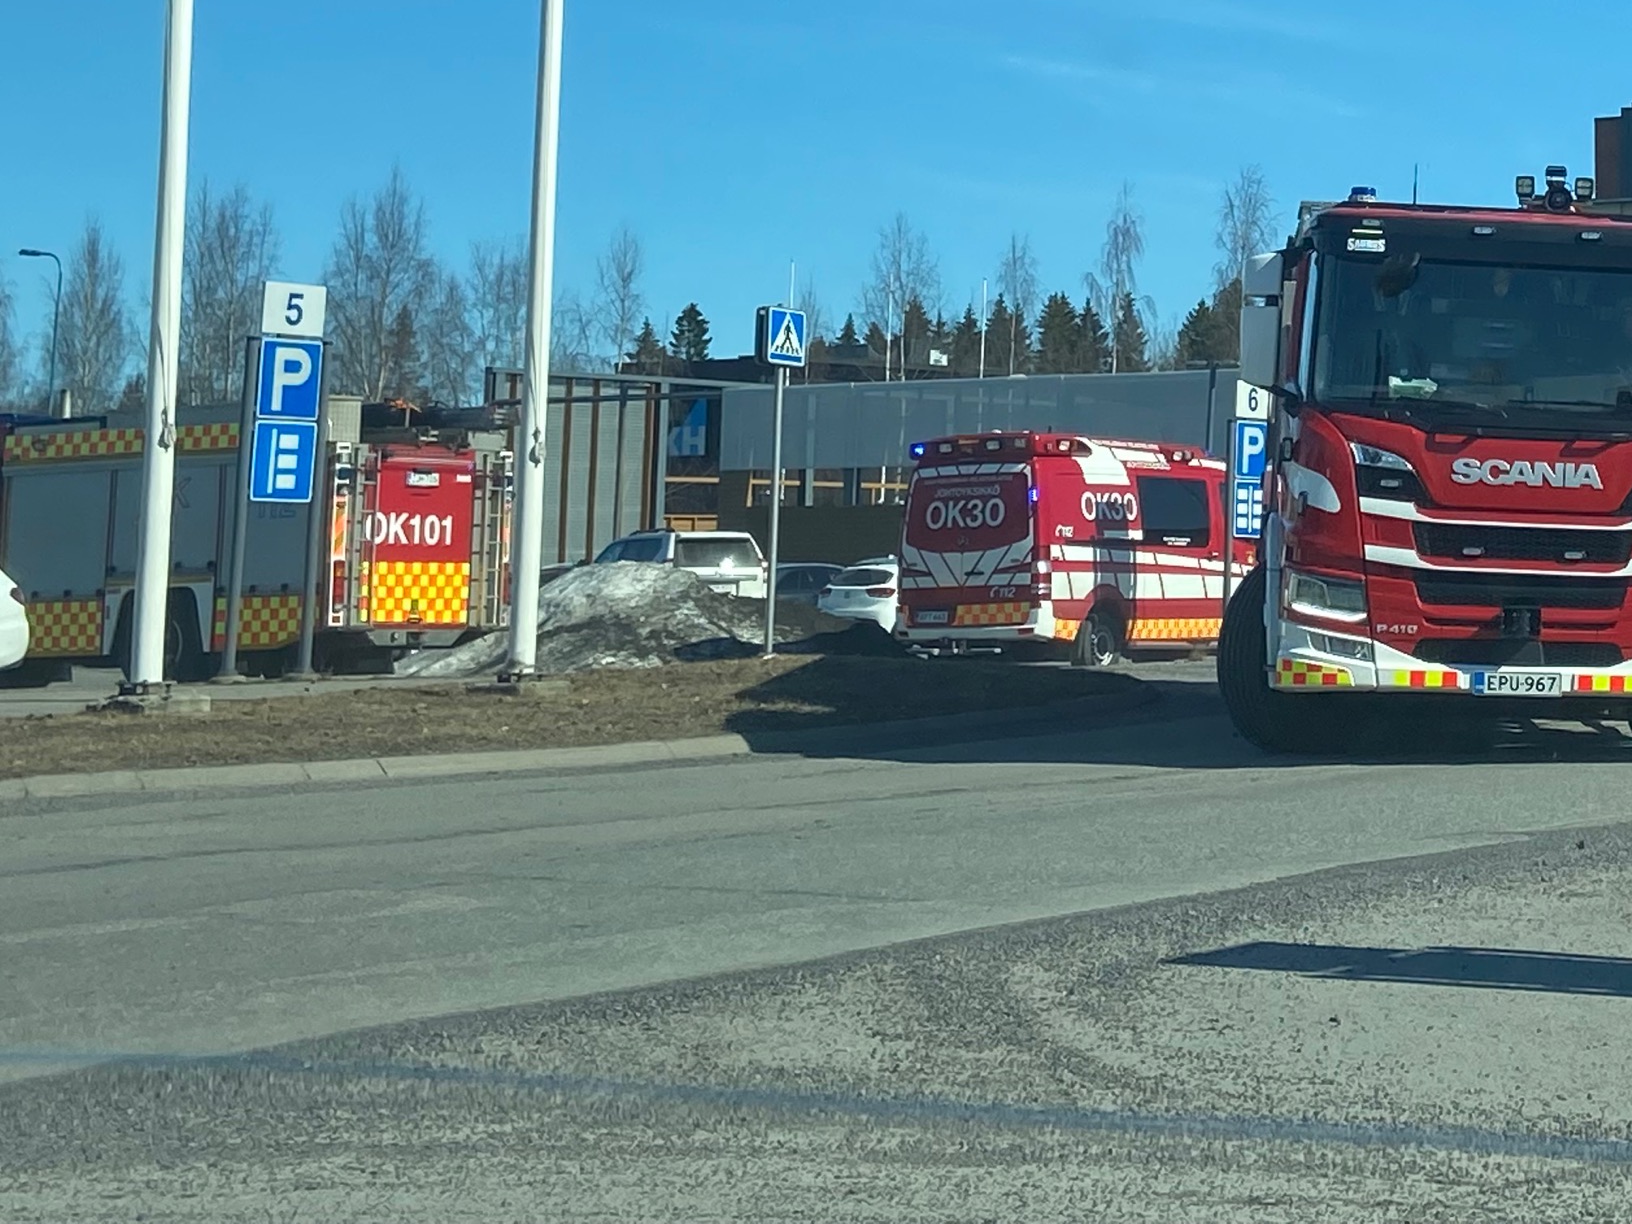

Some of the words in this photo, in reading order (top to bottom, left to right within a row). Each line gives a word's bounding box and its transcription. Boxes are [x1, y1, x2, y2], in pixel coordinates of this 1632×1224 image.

[284, 292, 304, 326] 5
[270, 346, 313, 412] P
[1248, 387, 1259, 412] 6
[1241, 425, 1265, 474] P
[1450, 457, 1604, 490] SCANIA
[925, 497, 1006, 530] OK30
[1080, 490, 1138, 522] OK30
[365, 511, 453, 546] OK101
[999, 586, 1016, 598] 112
[1376, 624, 1387, 634] P
[1389, 624, 1419, 635] 410
[1487, 675, 1558, 693] EPU-967
